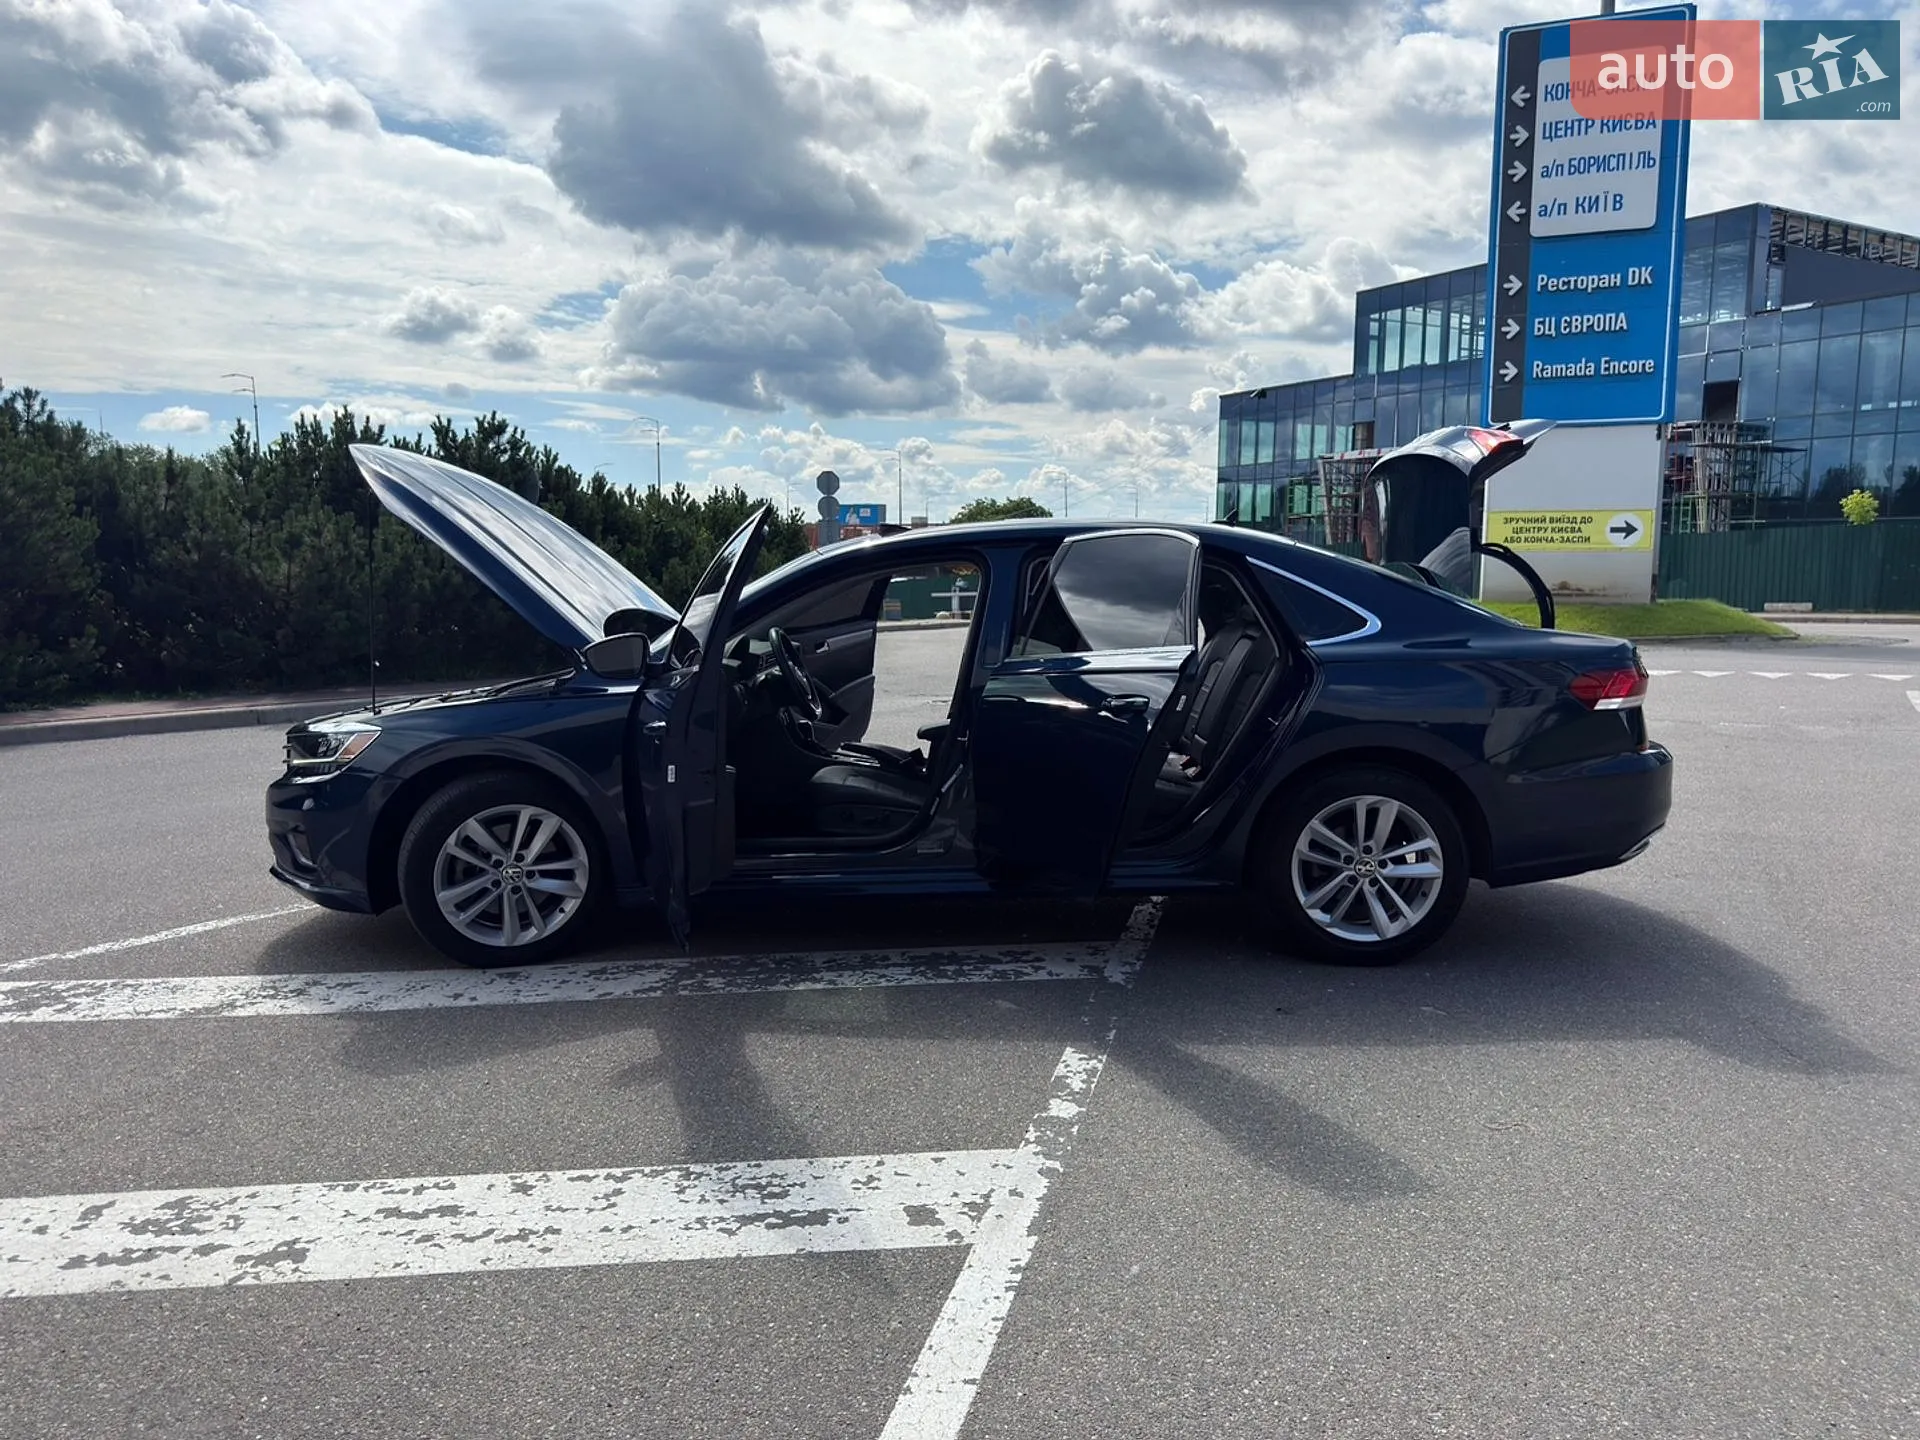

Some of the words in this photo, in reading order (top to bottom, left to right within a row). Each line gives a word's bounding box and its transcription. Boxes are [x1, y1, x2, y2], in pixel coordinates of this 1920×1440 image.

[1544, 73, 1657, 102] КОНЧА-ЗСА
[1542, 118, 1595, 142] ЦЕНТР
[1600, 112, 1657, 134] КИЄВА
[1541, 159, 1564, 179] а/п
[1538, 197, 1567, 218] а/п
[1575, 191, 1624, 214] КИЇВ
[1537, 273, 1621, 293] Ресторан
[1534, 317, 1556, 337] БЦ
[1561, 312, 1628, 335] ЄВРОПА
[1533, 358, 1595, 379] Ramada
[1600, 357, 1655, 375] Encore
[1503, 515, 1547, 525] ЗРУЧНИЙ
[1579, 516, 1593, 525] ДО
[1512, 526, 1549, 535] ЦЕНТРУ
[1550, 526, 1583, 534] КИЄВА
[1503, 536, 1522, 544] АБО
[1523, 536, 1591, 544] КОНЧА-ЗАСПИ
